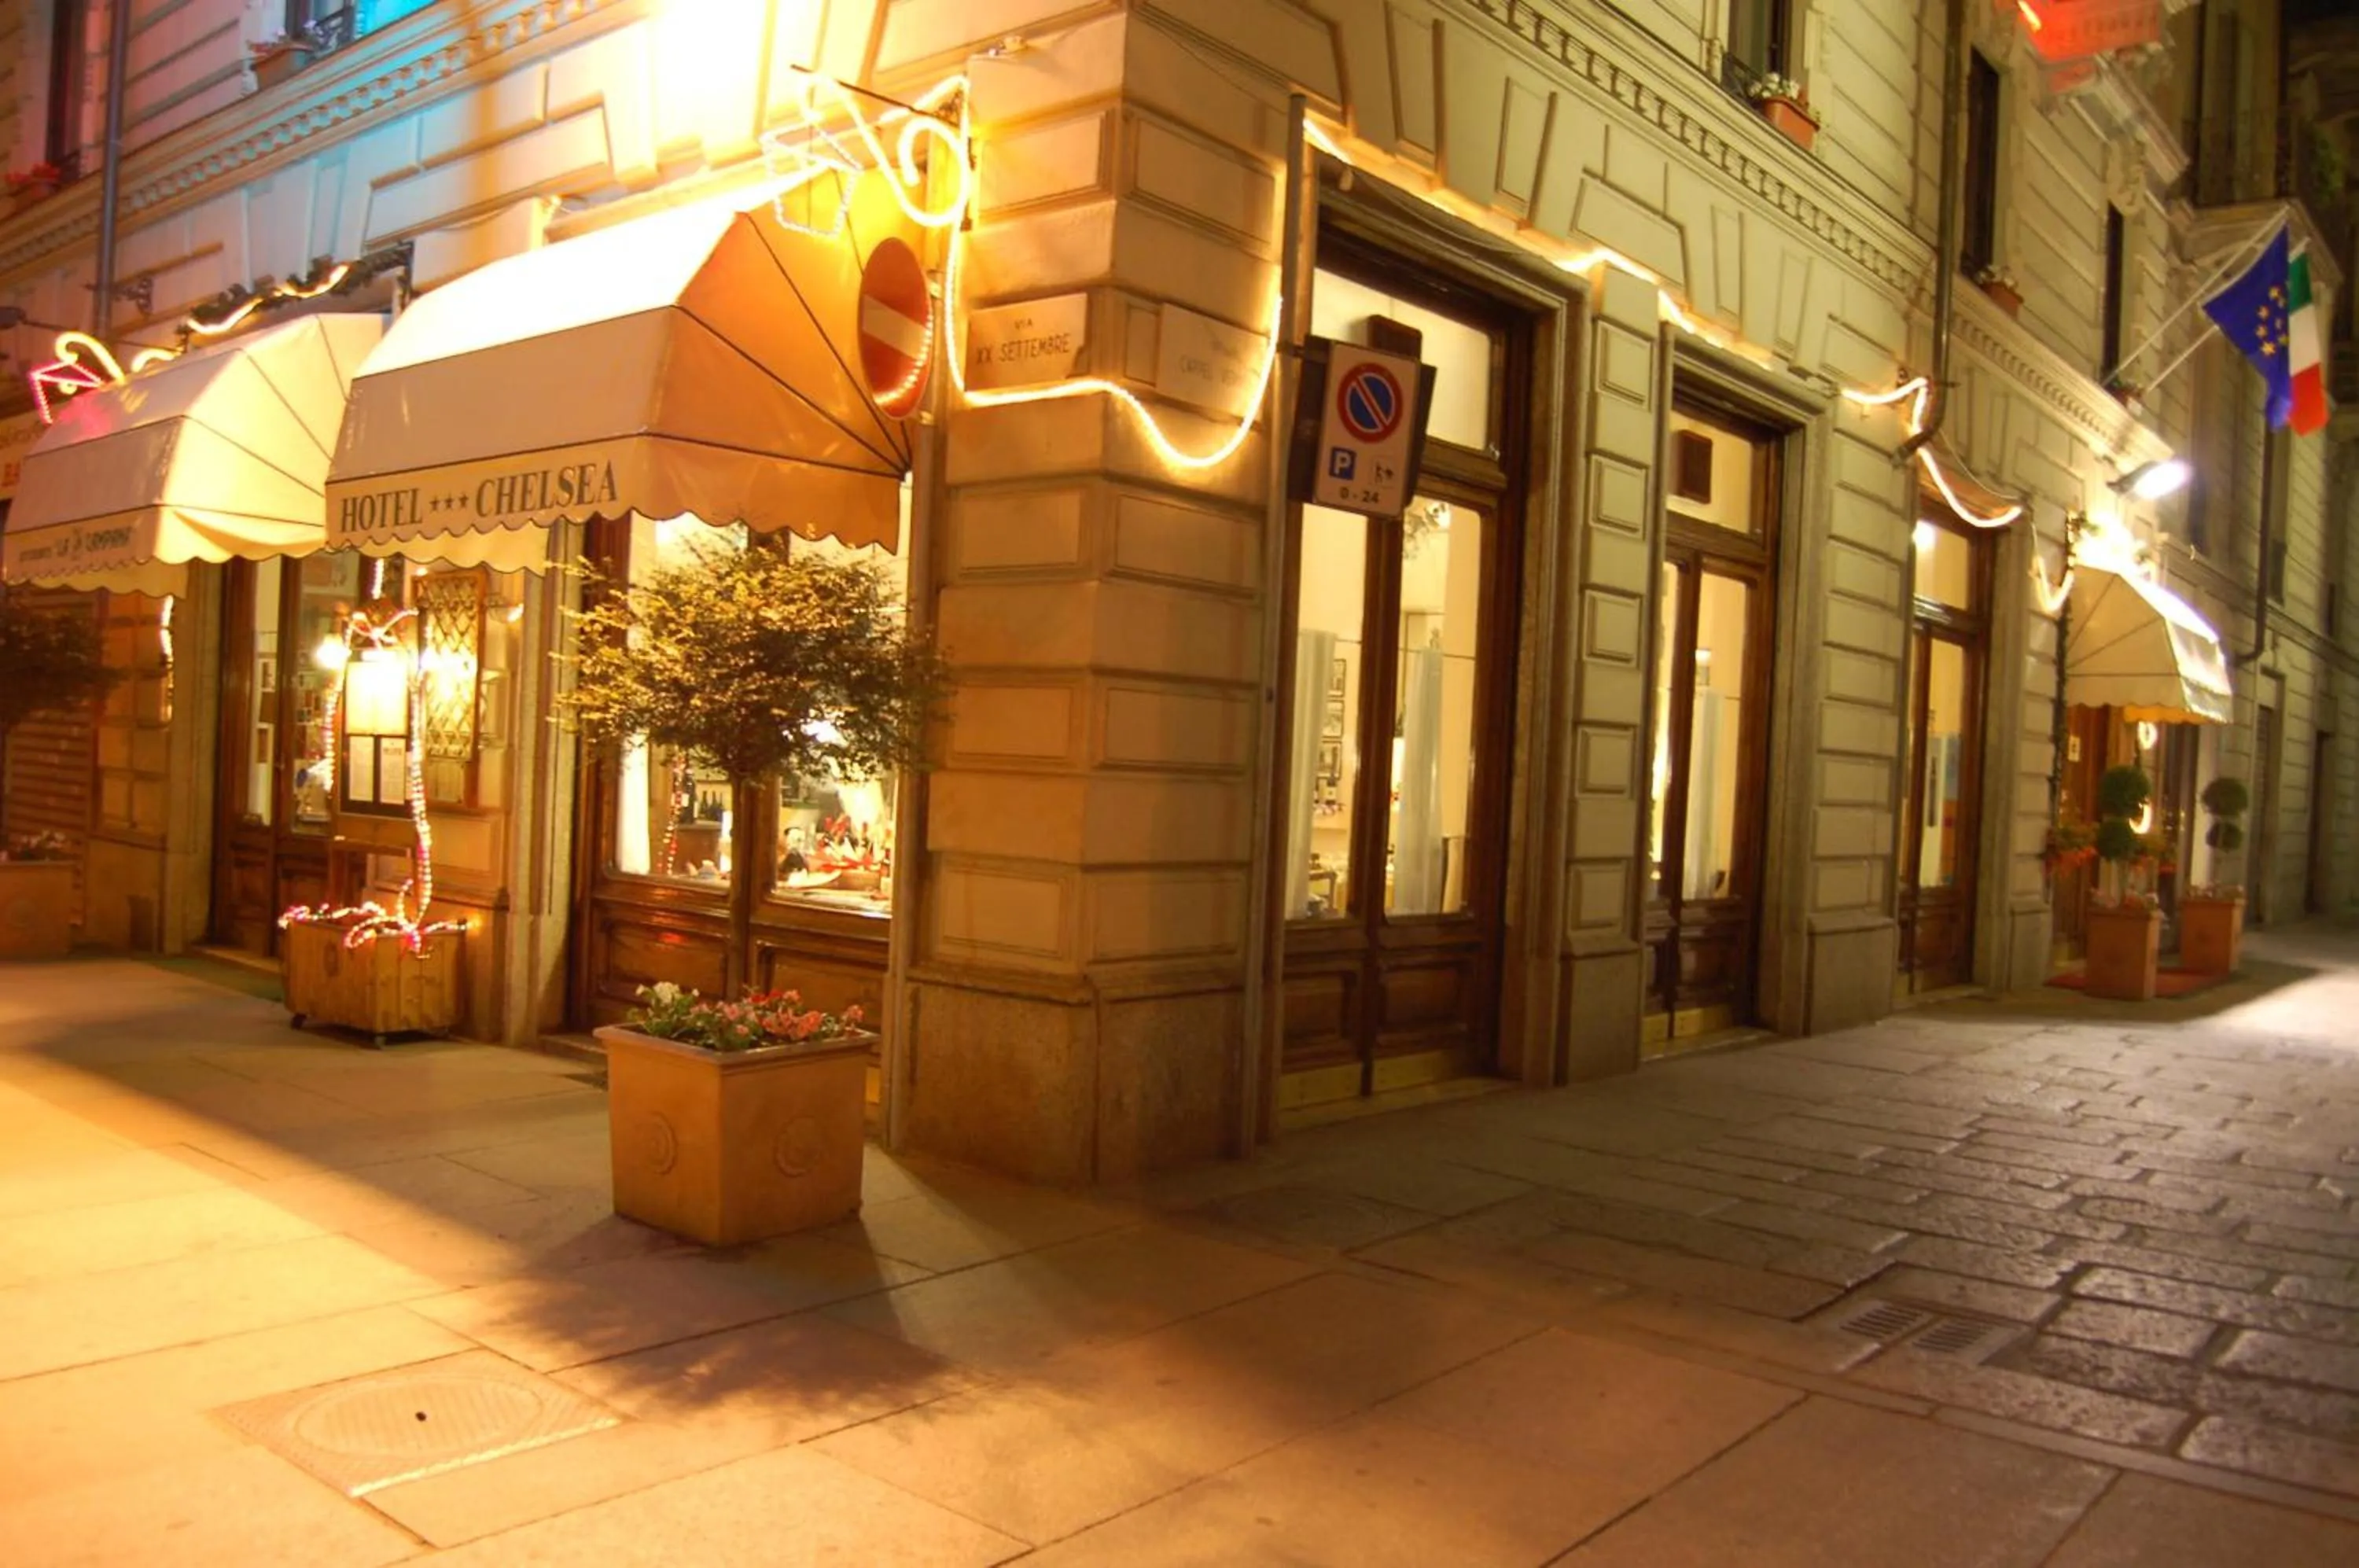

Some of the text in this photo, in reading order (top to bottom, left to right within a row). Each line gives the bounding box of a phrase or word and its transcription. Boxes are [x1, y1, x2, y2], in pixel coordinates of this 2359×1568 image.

[1014, 318, 1032, 329] VIA
[976, 333, 1070, 364] XX SETTEMBRE
[1334, 451, 1352, 476] P
[340, 460, 617, 533] HOTEL CHELSEA
[1362, 490, 1379, 503] 24
